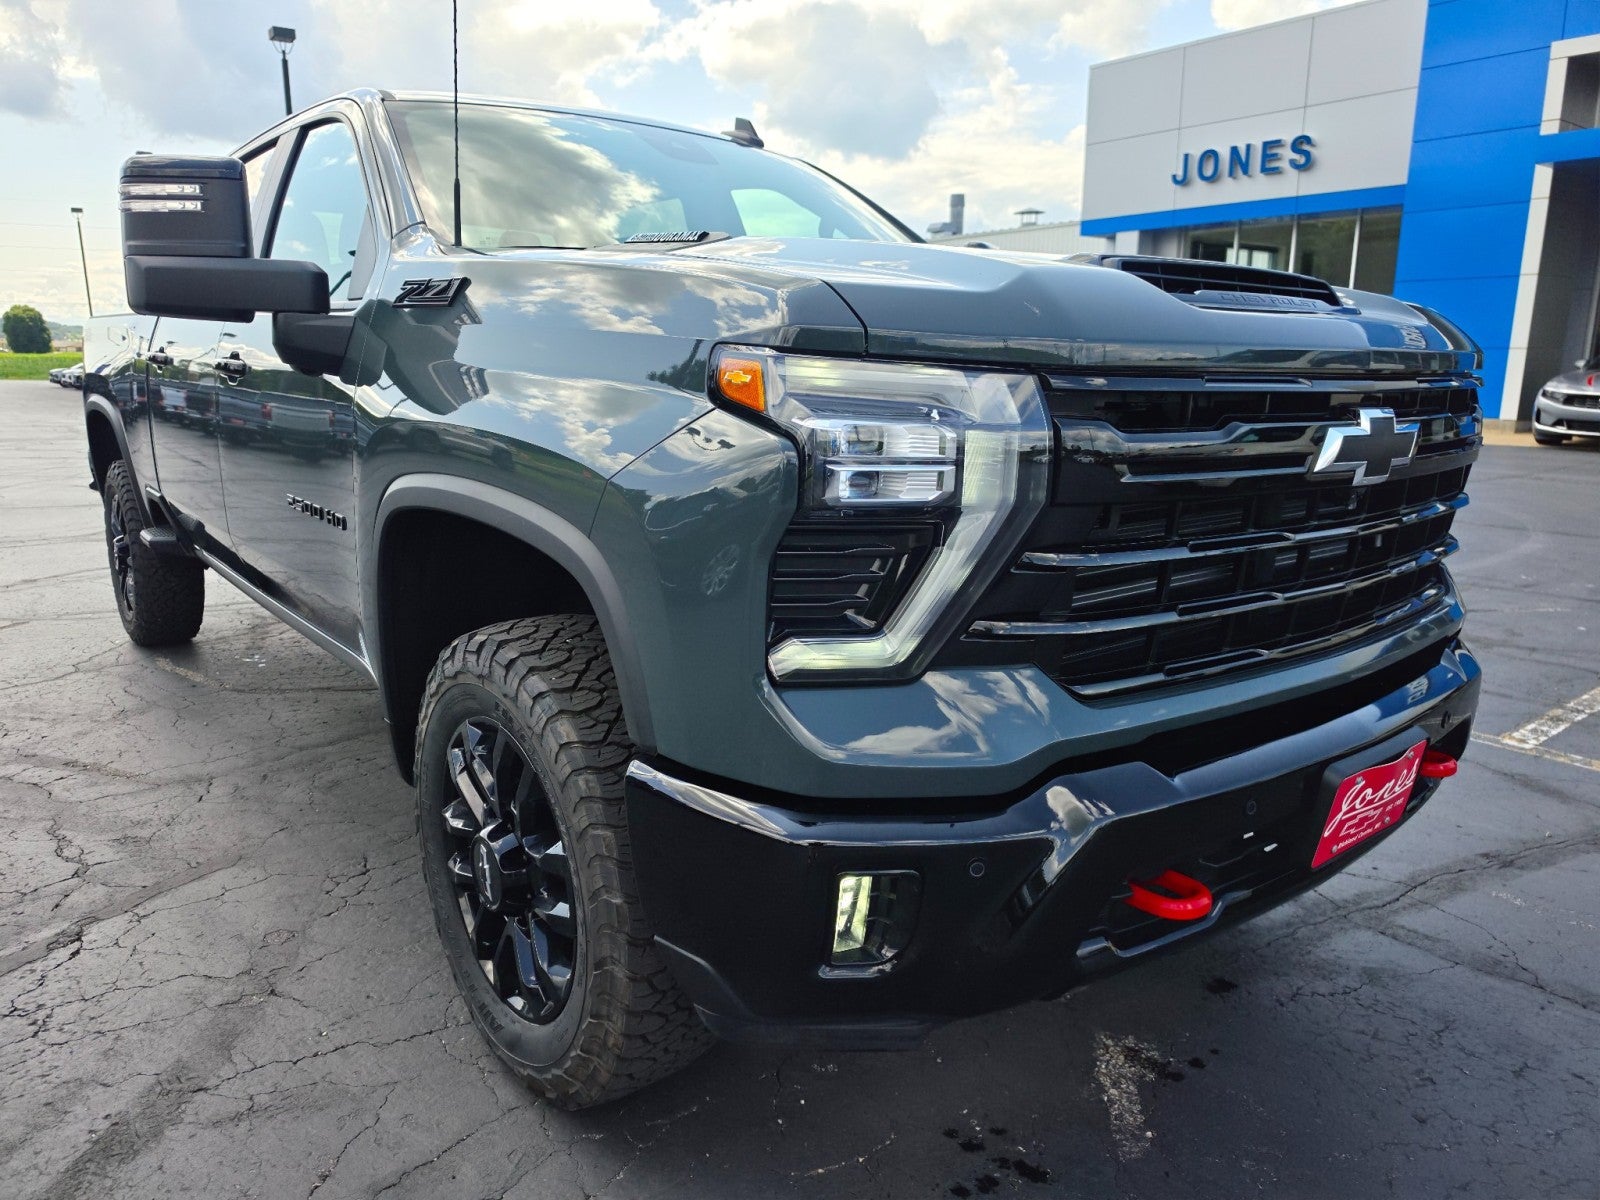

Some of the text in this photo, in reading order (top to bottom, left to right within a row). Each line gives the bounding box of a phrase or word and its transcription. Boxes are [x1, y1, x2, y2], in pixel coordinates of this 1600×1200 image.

[1171, 134, 1314, 187] JONES
[392, 277, 468, 308] Z71
[1324, 757, 1419, 838] Jones
